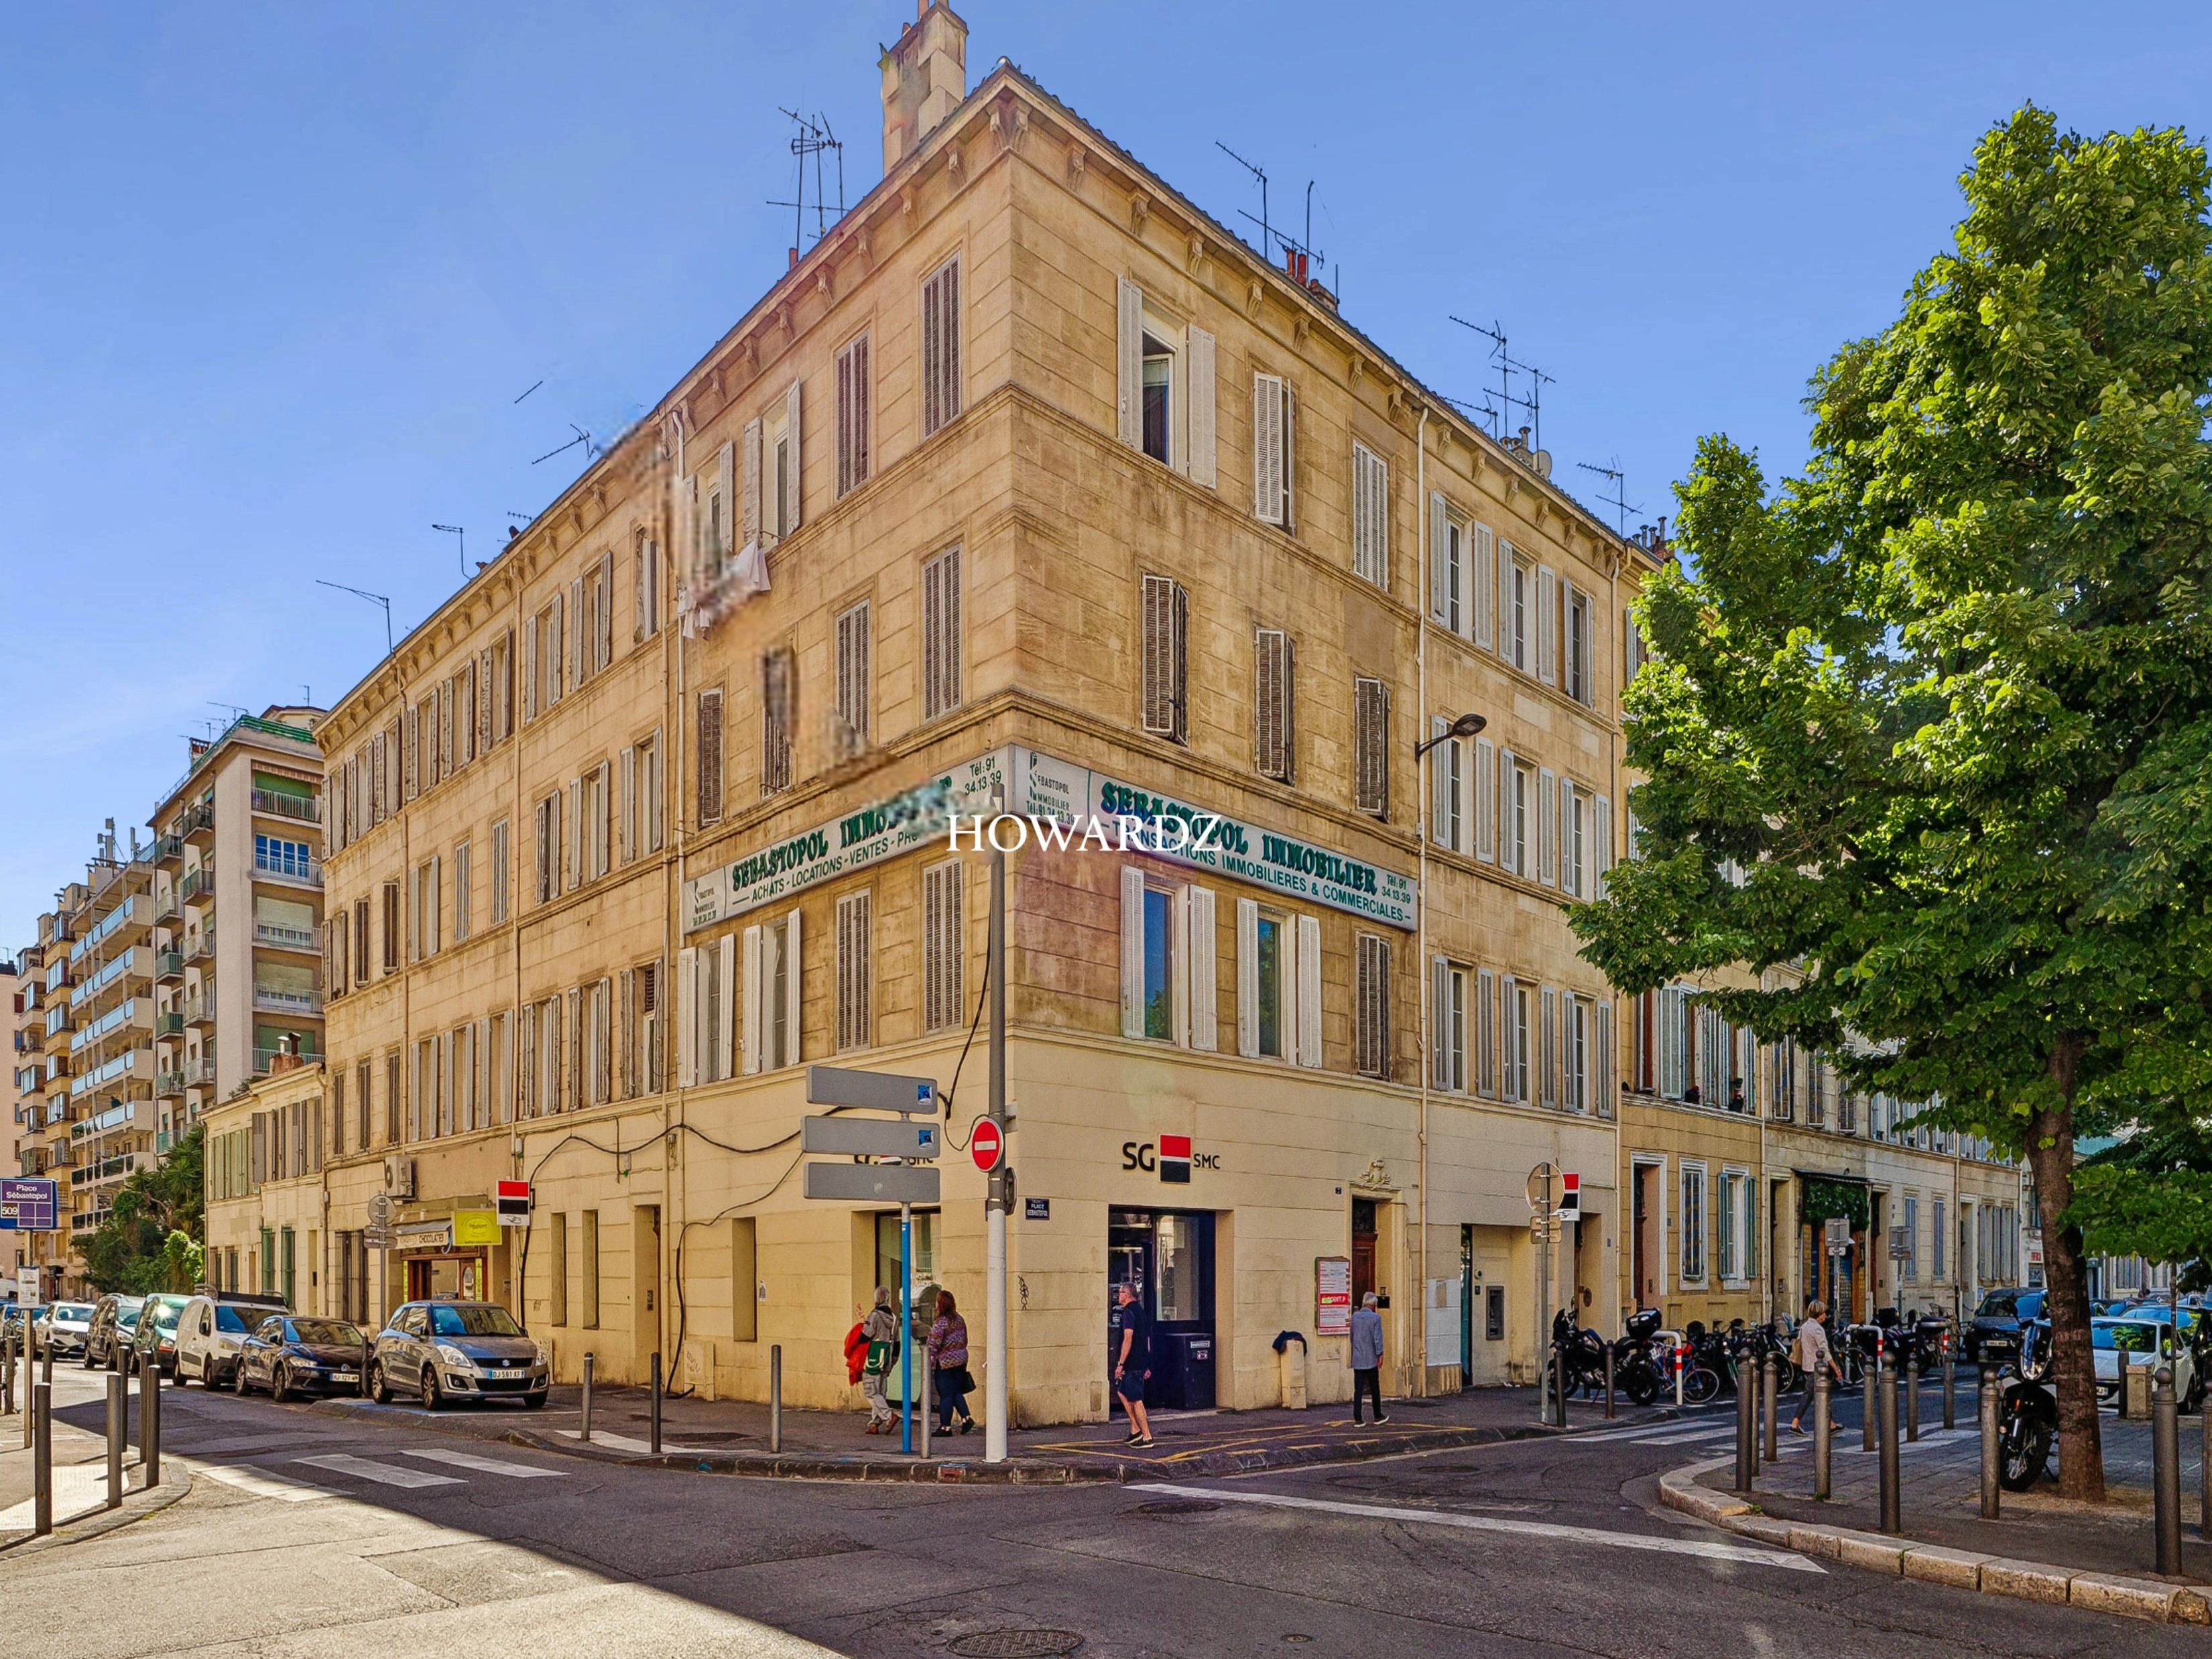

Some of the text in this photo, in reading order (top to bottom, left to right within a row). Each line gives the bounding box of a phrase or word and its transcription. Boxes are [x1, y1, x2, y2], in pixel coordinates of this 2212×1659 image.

[965, 770, 1001, 796] 34.13.39
[733, 828, 828, 892] SEBASTOPOL
[1101, 782, 1377, 896] SEBASTOPOL IMMOBILIER
[752, 878, 784, 902] ACHATS
[792, 856, 842, 887] LOCATIONS
[849, 837, 889, 865] VENTES
[1222, 853, 1306, 892] IMMOBILIERES
[1323, 884, 1404, 922] COMMERCIALES
[1381, 885, 1411, 904] 34.13.39
[1122, 1142, 1221, 1172] SG SMC
[2, 1207, 18, 1215] 509
